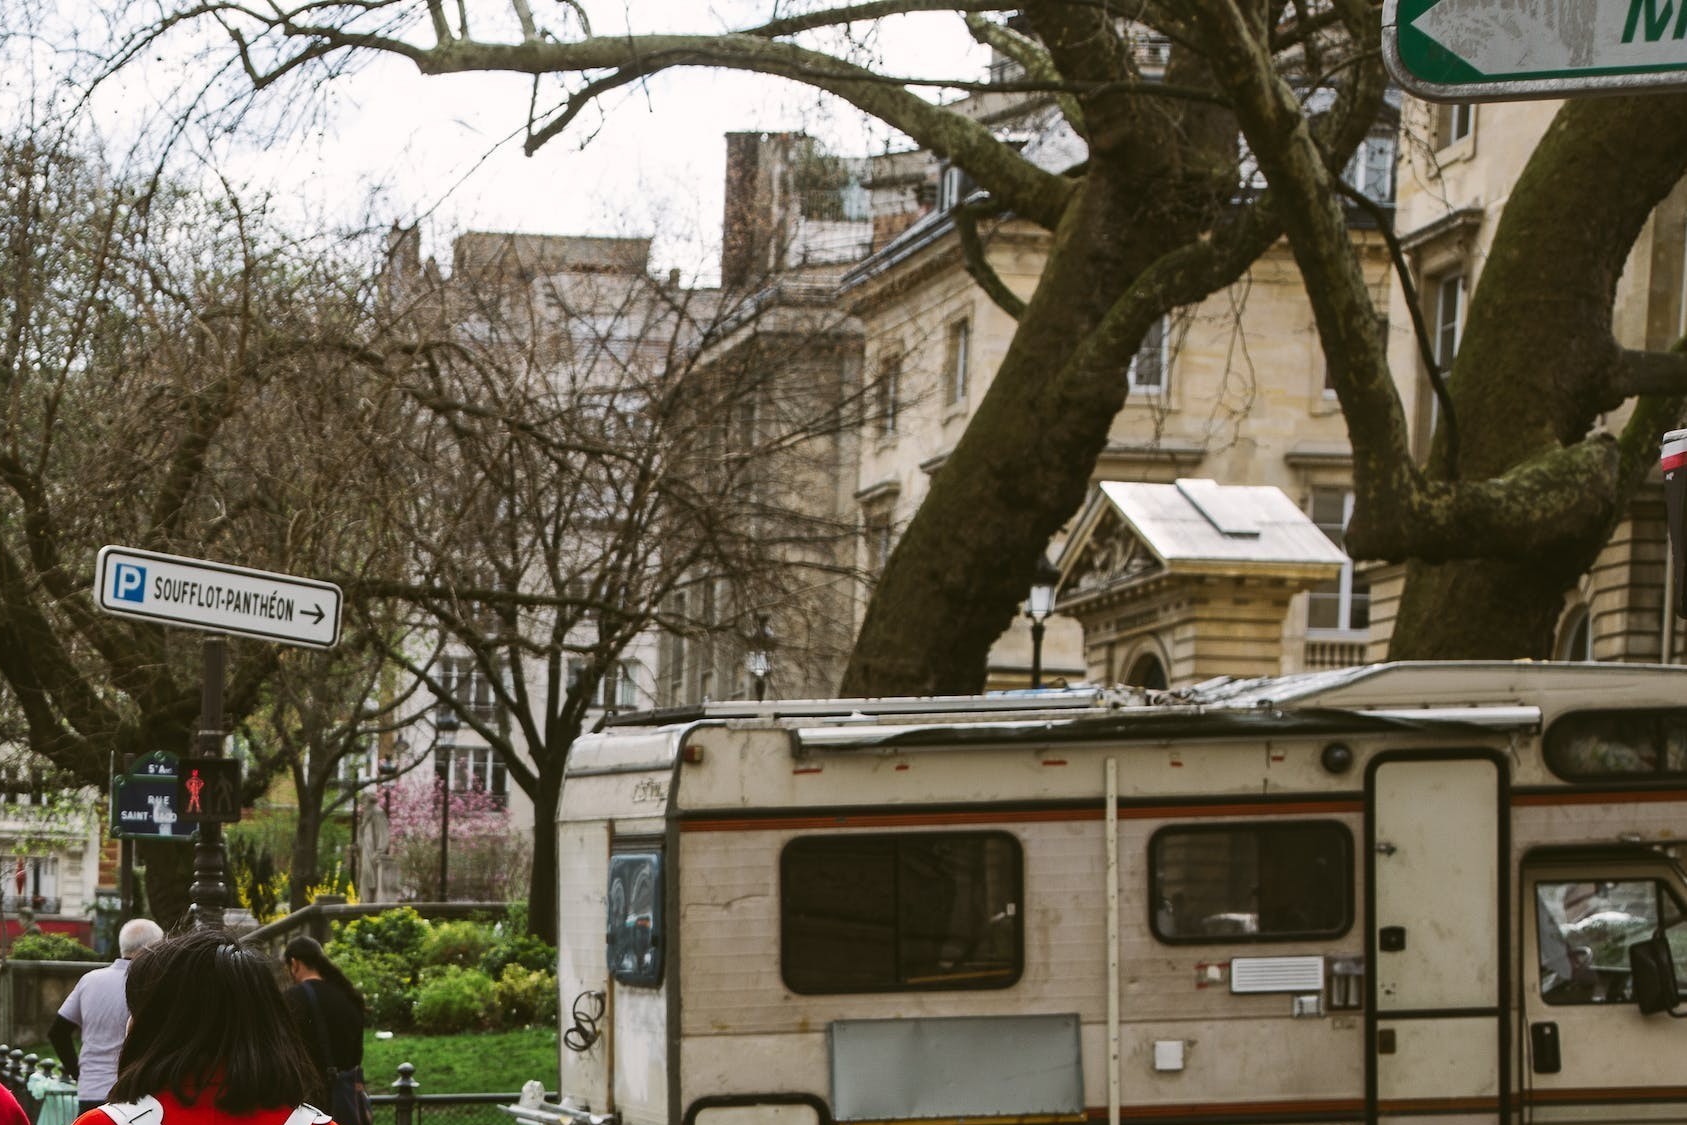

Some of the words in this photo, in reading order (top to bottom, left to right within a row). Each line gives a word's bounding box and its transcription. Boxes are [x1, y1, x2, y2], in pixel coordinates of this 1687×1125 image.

[117, 565, 142, 599] P
[153, 576, 296, 622] SOUFFLOT-PANTHÉON
[147, 795, 170, 805] RUE
